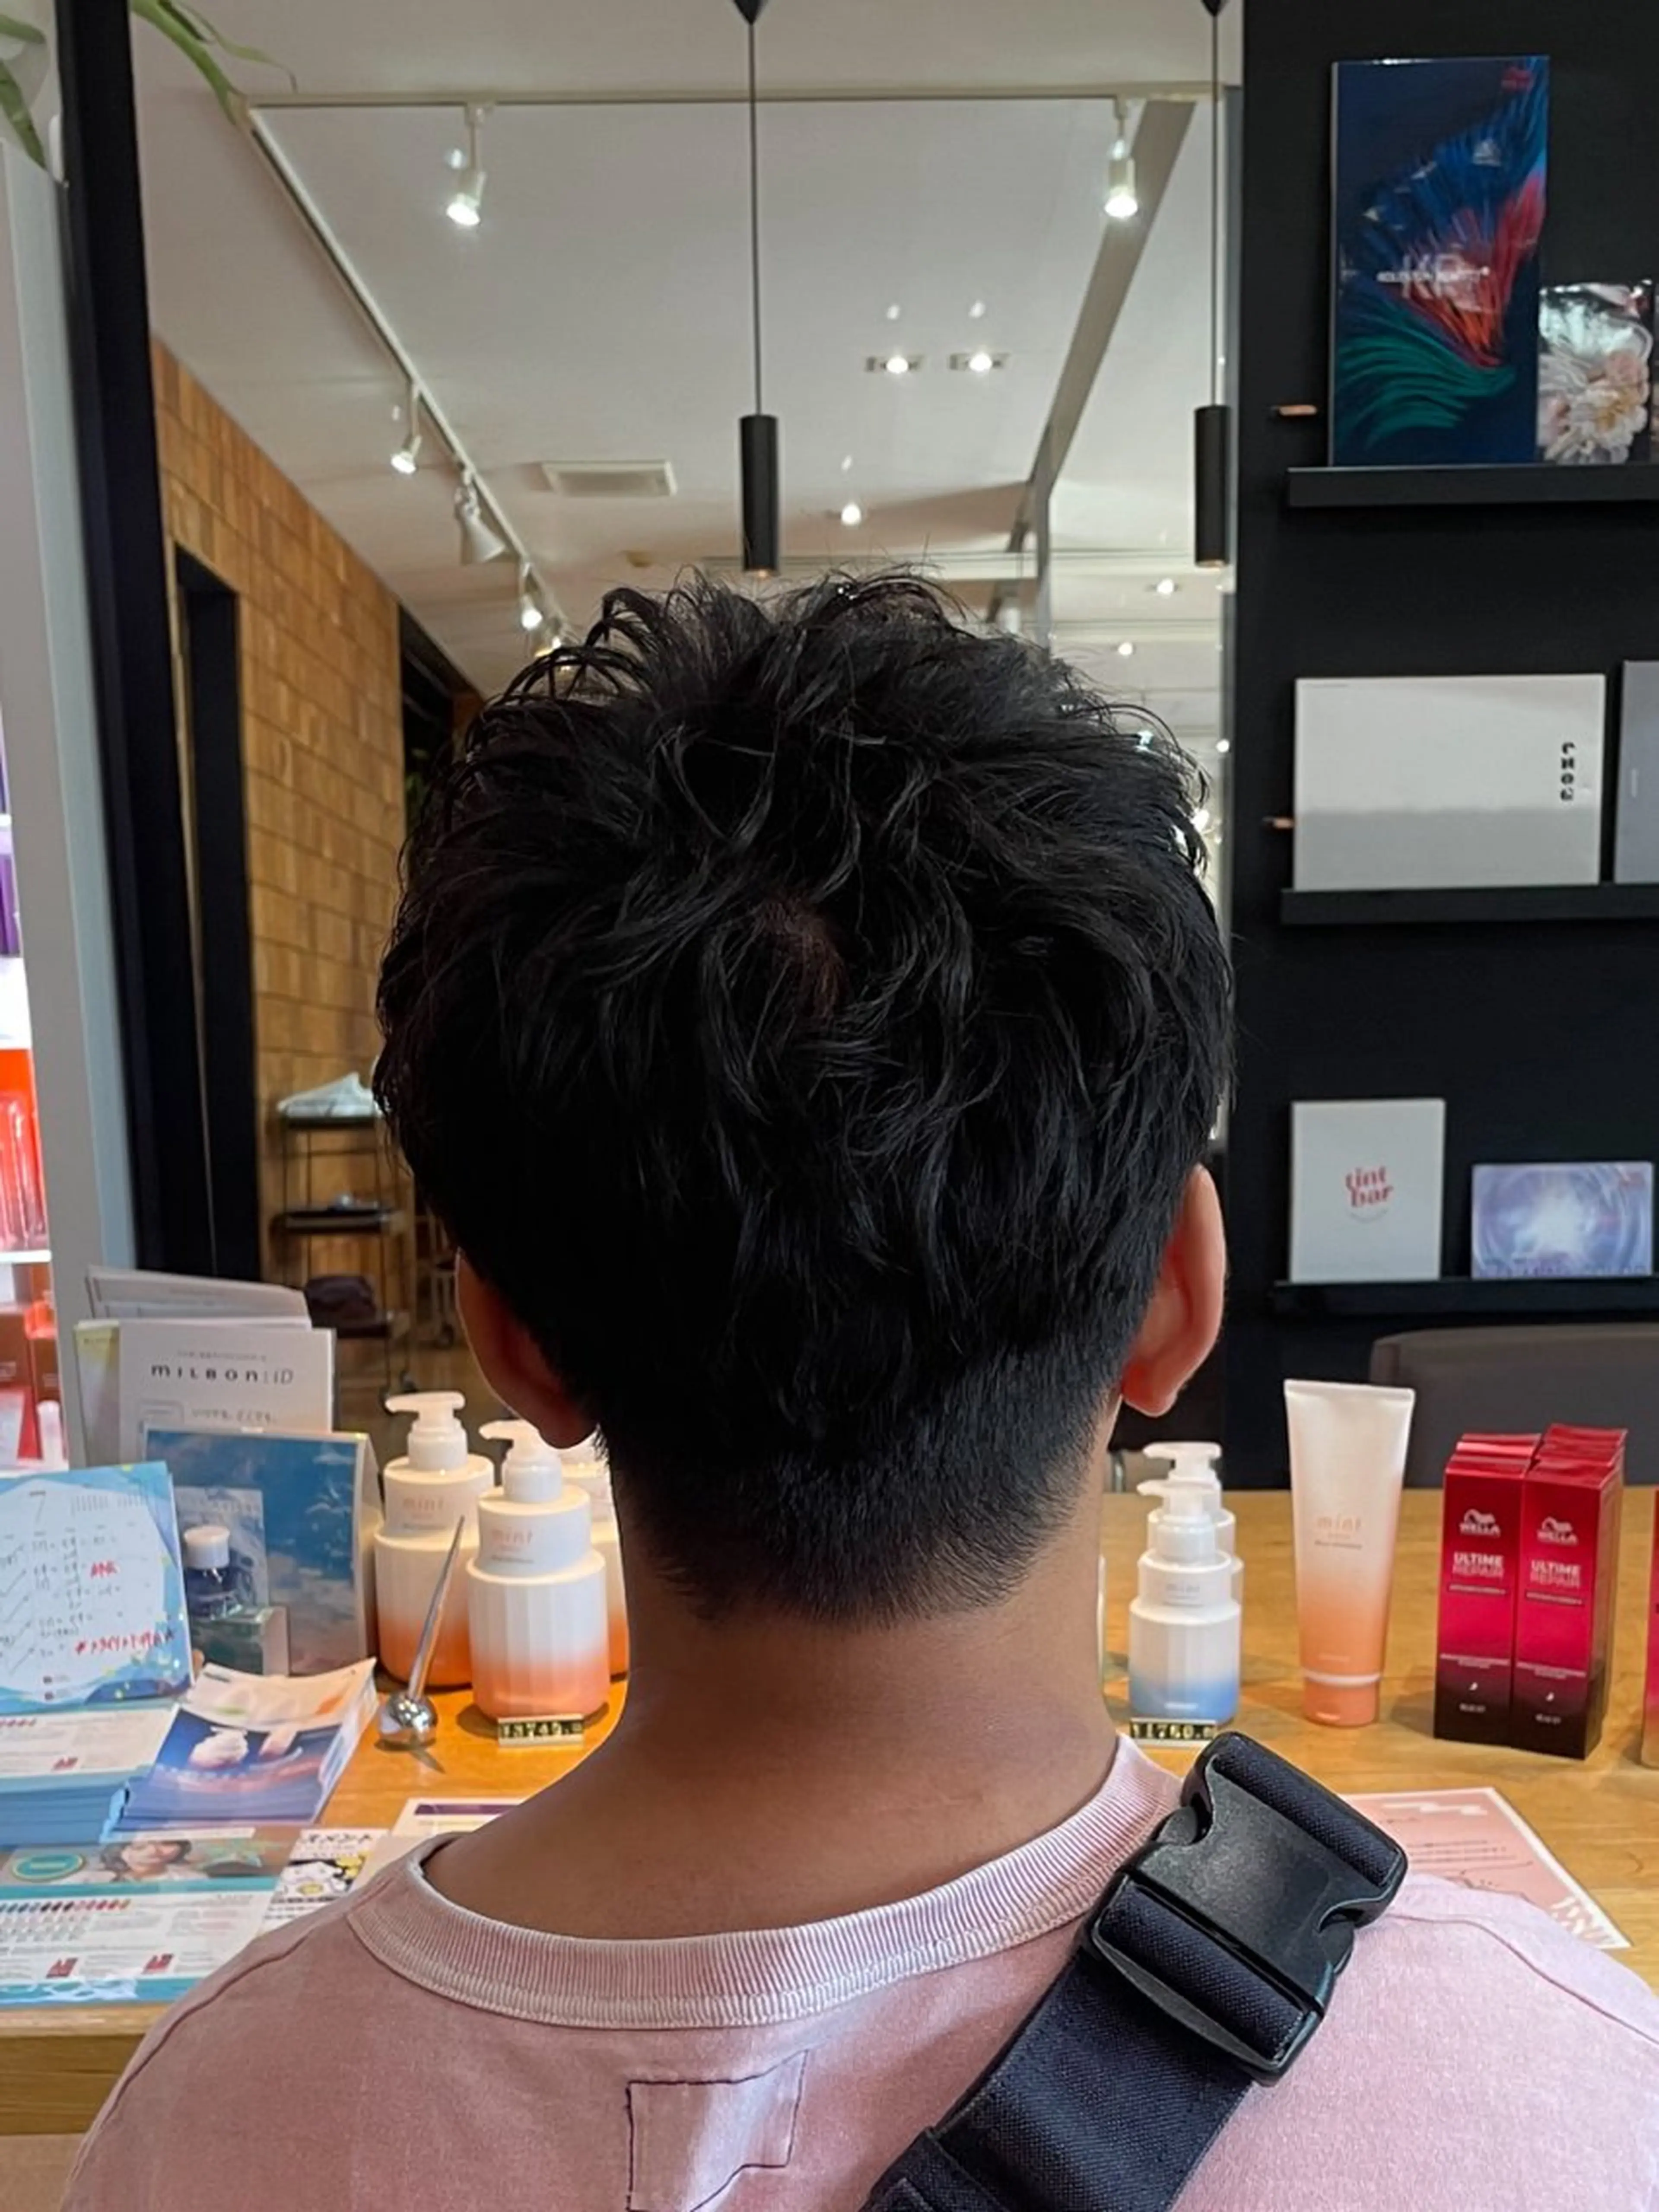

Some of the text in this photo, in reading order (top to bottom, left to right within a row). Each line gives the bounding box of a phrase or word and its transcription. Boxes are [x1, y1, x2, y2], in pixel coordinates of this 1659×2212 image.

[1345, 1166, 1386, 1189] tint
[1351, 1185, 1394, 1208] bar
[1459, 1523, 1501, 1538] WELLA
[1537, 1530, 1579, 1546] WELLA
[1453, 1551, 1504, 1566] ULTIME
[1532, 1560, 1581, 1576] ULTIME
